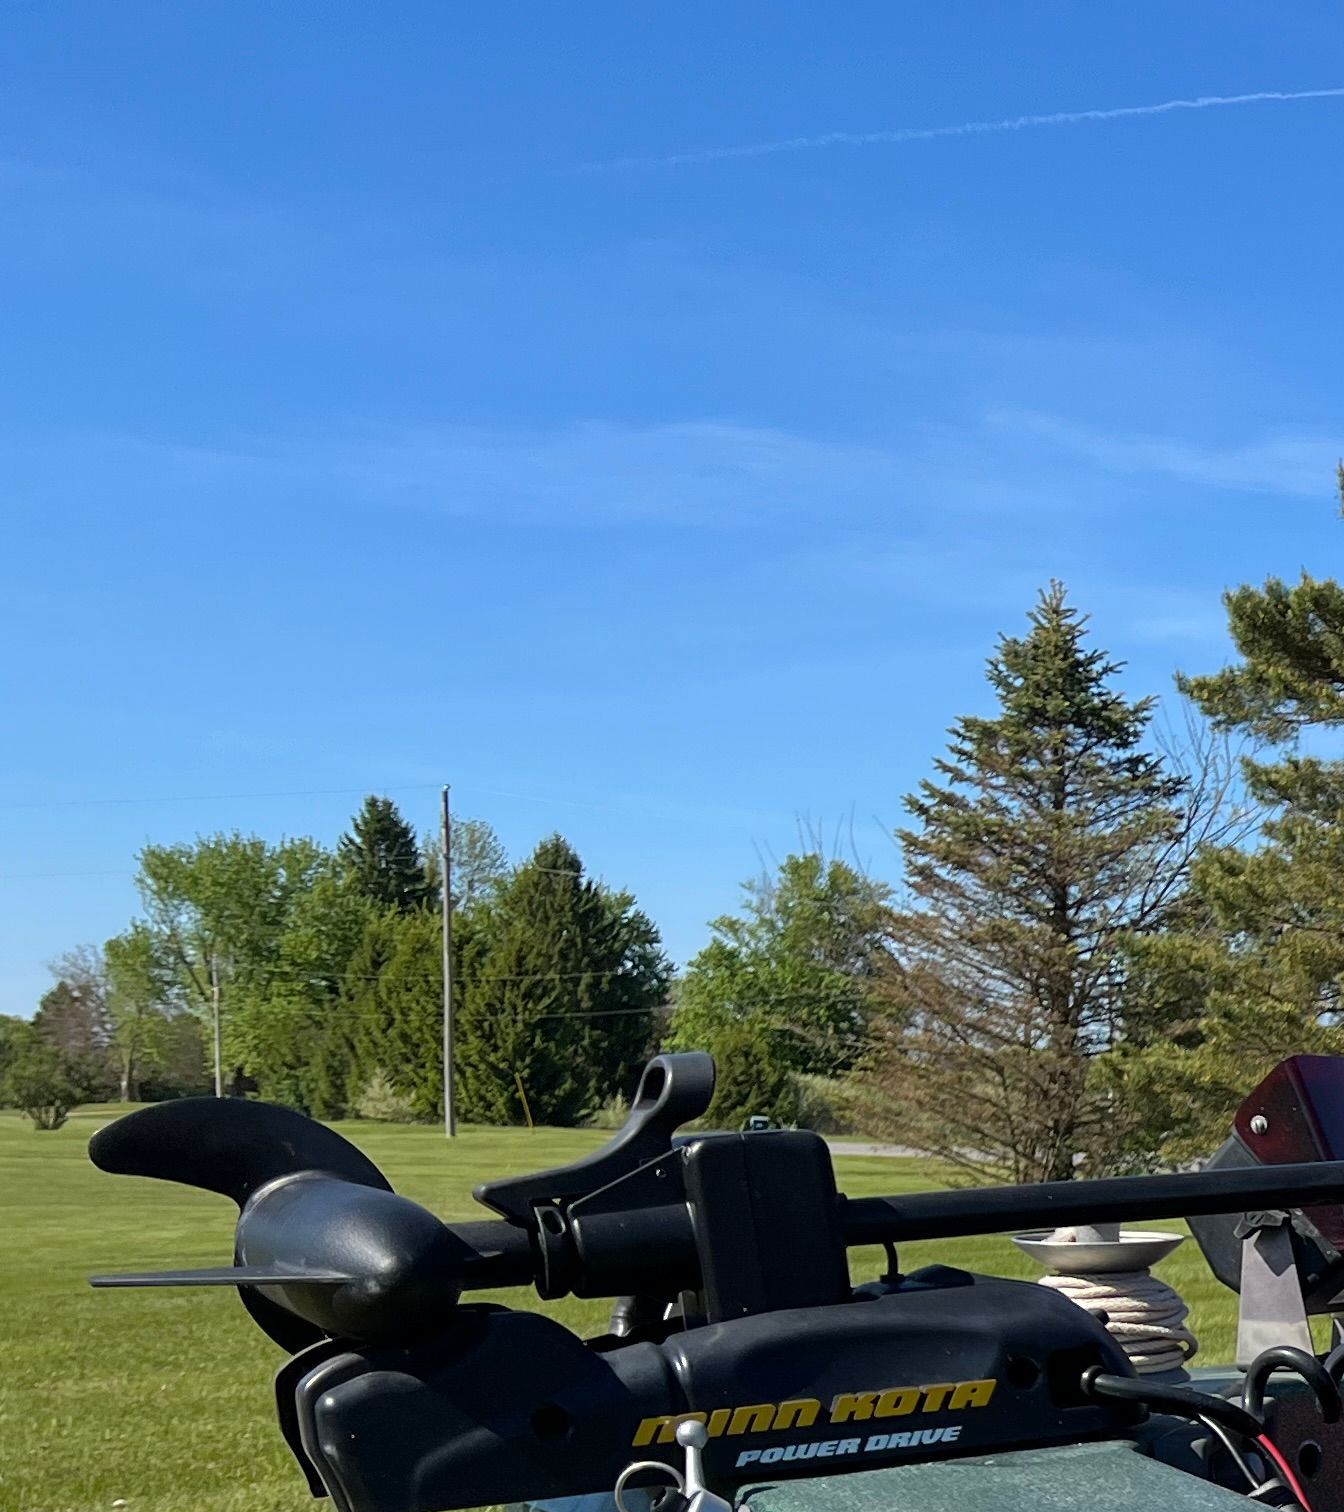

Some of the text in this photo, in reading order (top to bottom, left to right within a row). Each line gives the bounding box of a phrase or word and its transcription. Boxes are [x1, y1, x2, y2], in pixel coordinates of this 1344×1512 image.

[632, 1378, 998, 1447] MINN KOTA
[735, 1425, 962, 1467] POWER DRIVE
